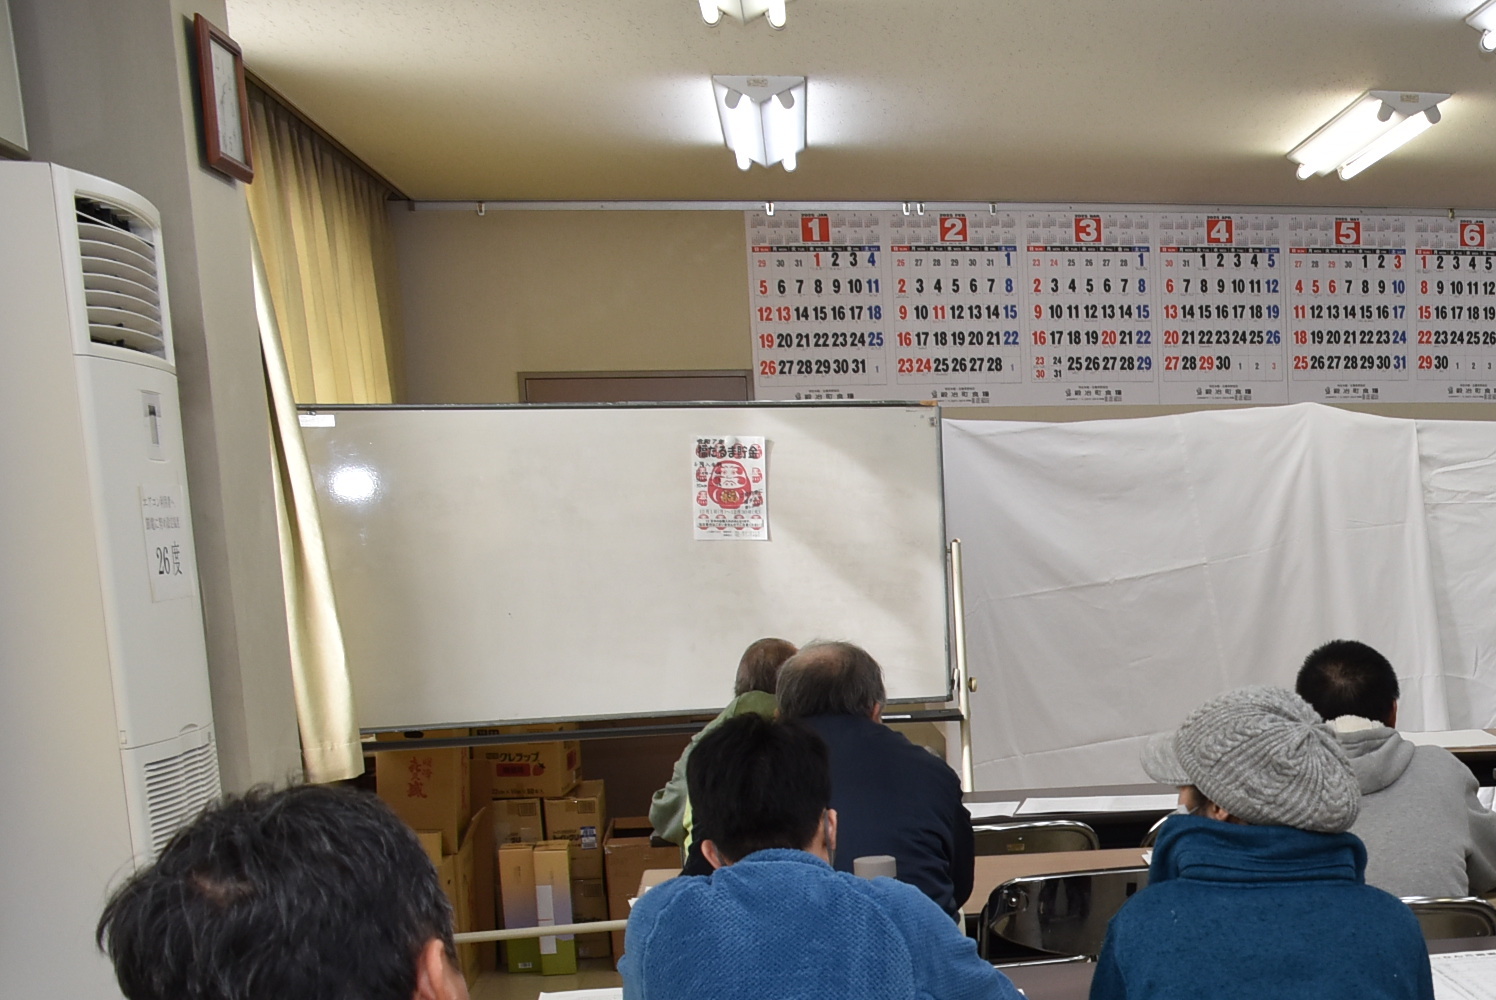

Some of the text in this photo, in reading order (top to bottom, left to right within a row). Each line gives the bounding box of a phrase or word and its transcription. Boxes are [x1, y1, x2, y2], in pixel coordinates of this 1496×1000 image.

[808, 218, 821, 241] 1
[944, 218, 963, 241] 2
[1079, 218, 1097, 242] 3
[1210, 219, 1229, 242] 4
[1339, 222, 1356, 244] 5
[1464, 224, 1481, 246] 6
[1166, 278, 1279, 294] 6 7 8 9 10 11 12
[757, 305, 882, 322] 12 13 14 15 16 17 18
[1034, 304, 1150, 319] 9 10 11 12 13 14 15
[1418, 305, 1431, 319] 15
[1434, 305, 1447, 320] 16
[1450, 306, 1463, 320] 17
[1467, 306, 1480, 320] 18
[1483, 306, 1496, 321] 19
[897, 330, 1019, 347] 16 17 18 19 20 21 22
[1294, 330, 1407, 345] 18 19 20 21 22 23 24
